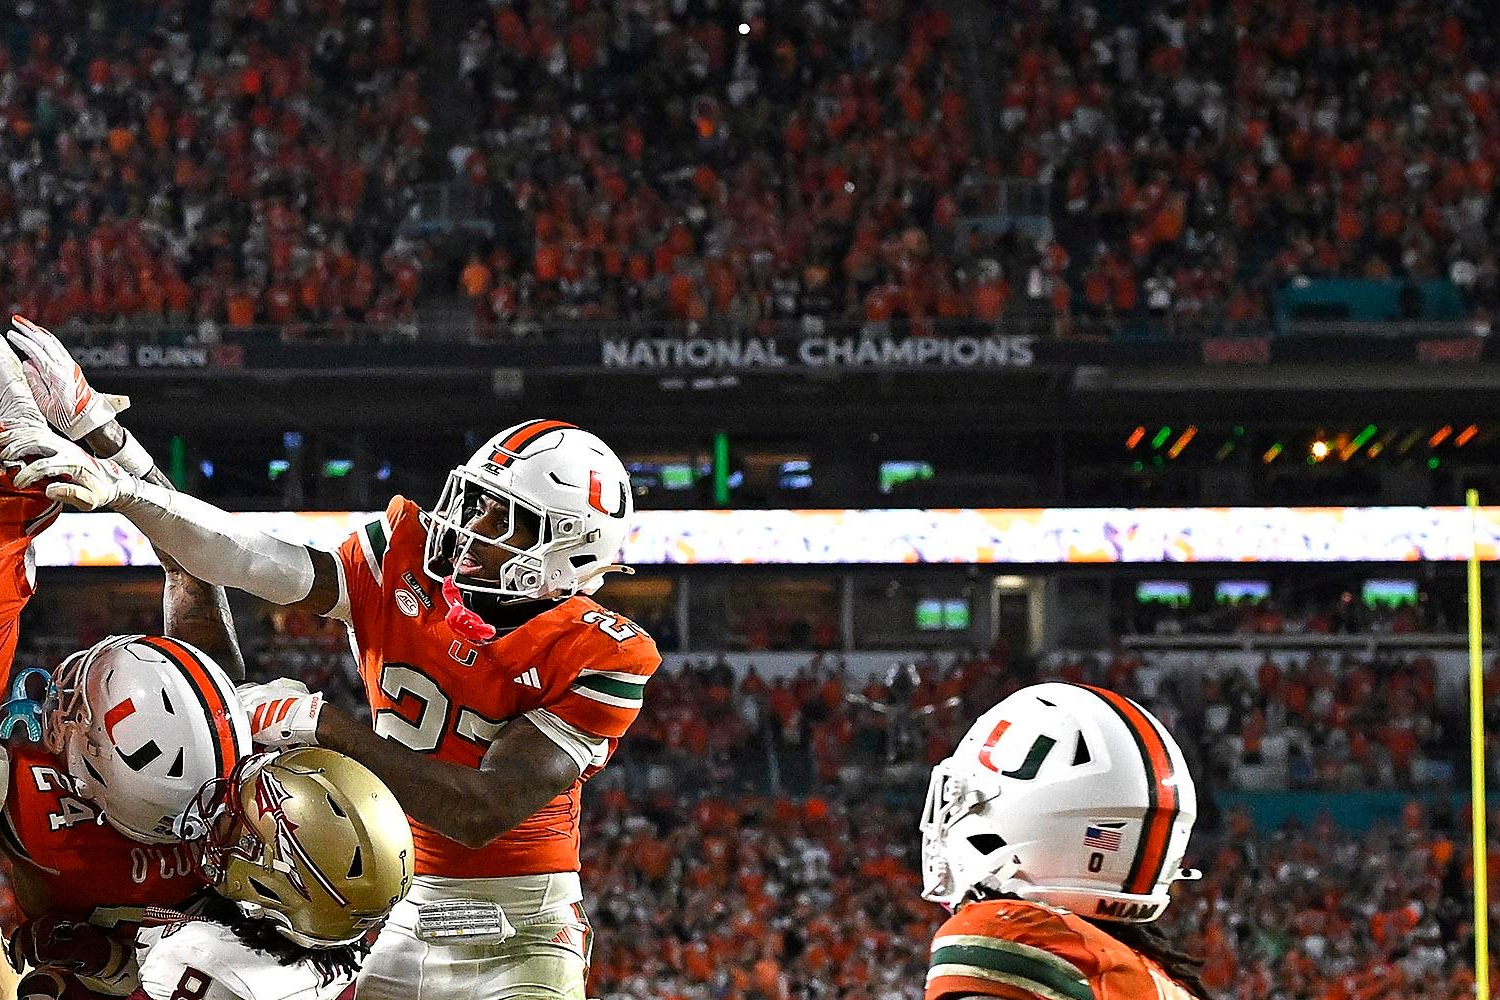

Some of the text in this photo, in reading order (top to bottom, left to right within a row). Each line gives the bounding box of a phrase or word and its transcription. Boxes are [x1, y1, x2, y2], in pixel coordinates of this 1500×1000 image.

[601, 337, 1034, 367] NATIONAL CHAMPIONS
[104, 697, 164, 772] U
[978, 719, 1057, 781] U
[1088, 851, 1105, 873] 0
[1095, 898, 1160, 919] MIAM
